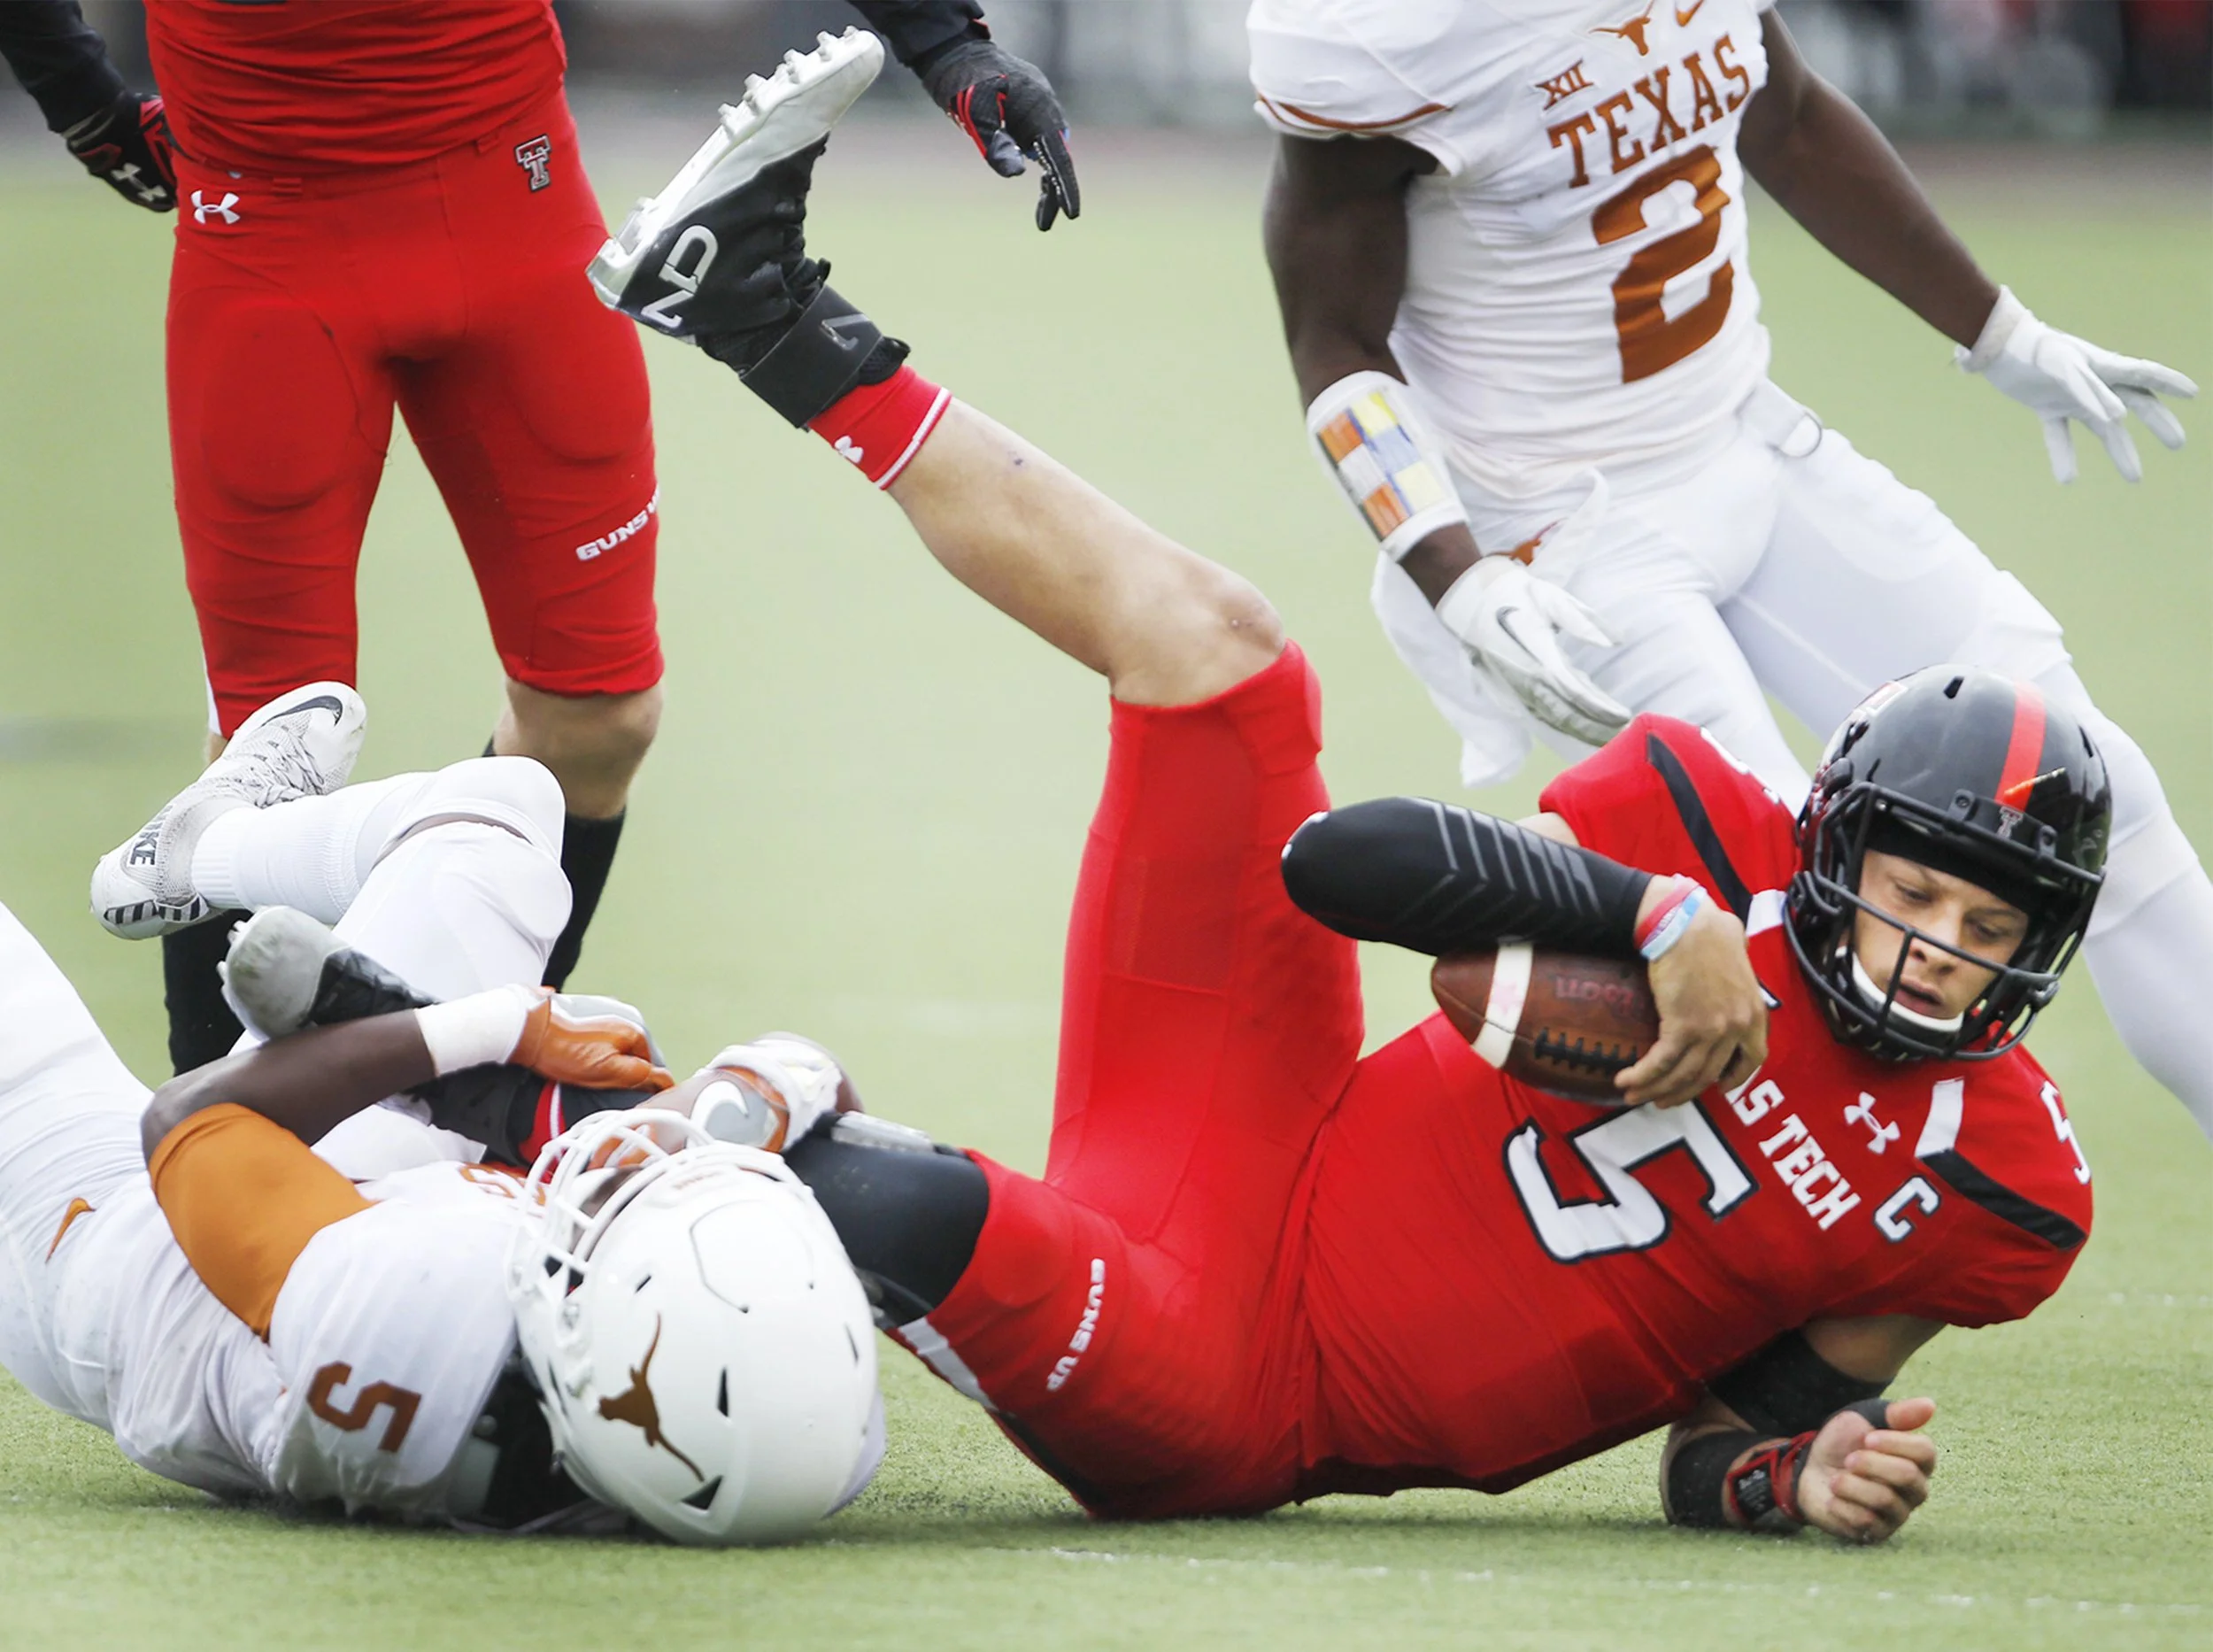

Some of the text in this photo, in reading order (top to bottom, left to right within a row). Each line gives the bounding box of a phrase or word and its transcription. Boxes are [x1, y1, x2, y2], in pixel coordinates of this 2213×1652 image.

[1535, 58, 1594, 111] XII
[1546, 36, 1750, 189] TEXAS
[1591, 143, 1734, 384] 2
[575, 509, 649, 561] GUNS
[1503, 1095, 1760, 1264] 5
[1758, 1113, 1862, 1231] TECH
[1873, 1173, 1940, 1243] C
[1045, 1258, 1106, 1392] GUNS UP
[306, 1360, 421, 1453] 5
